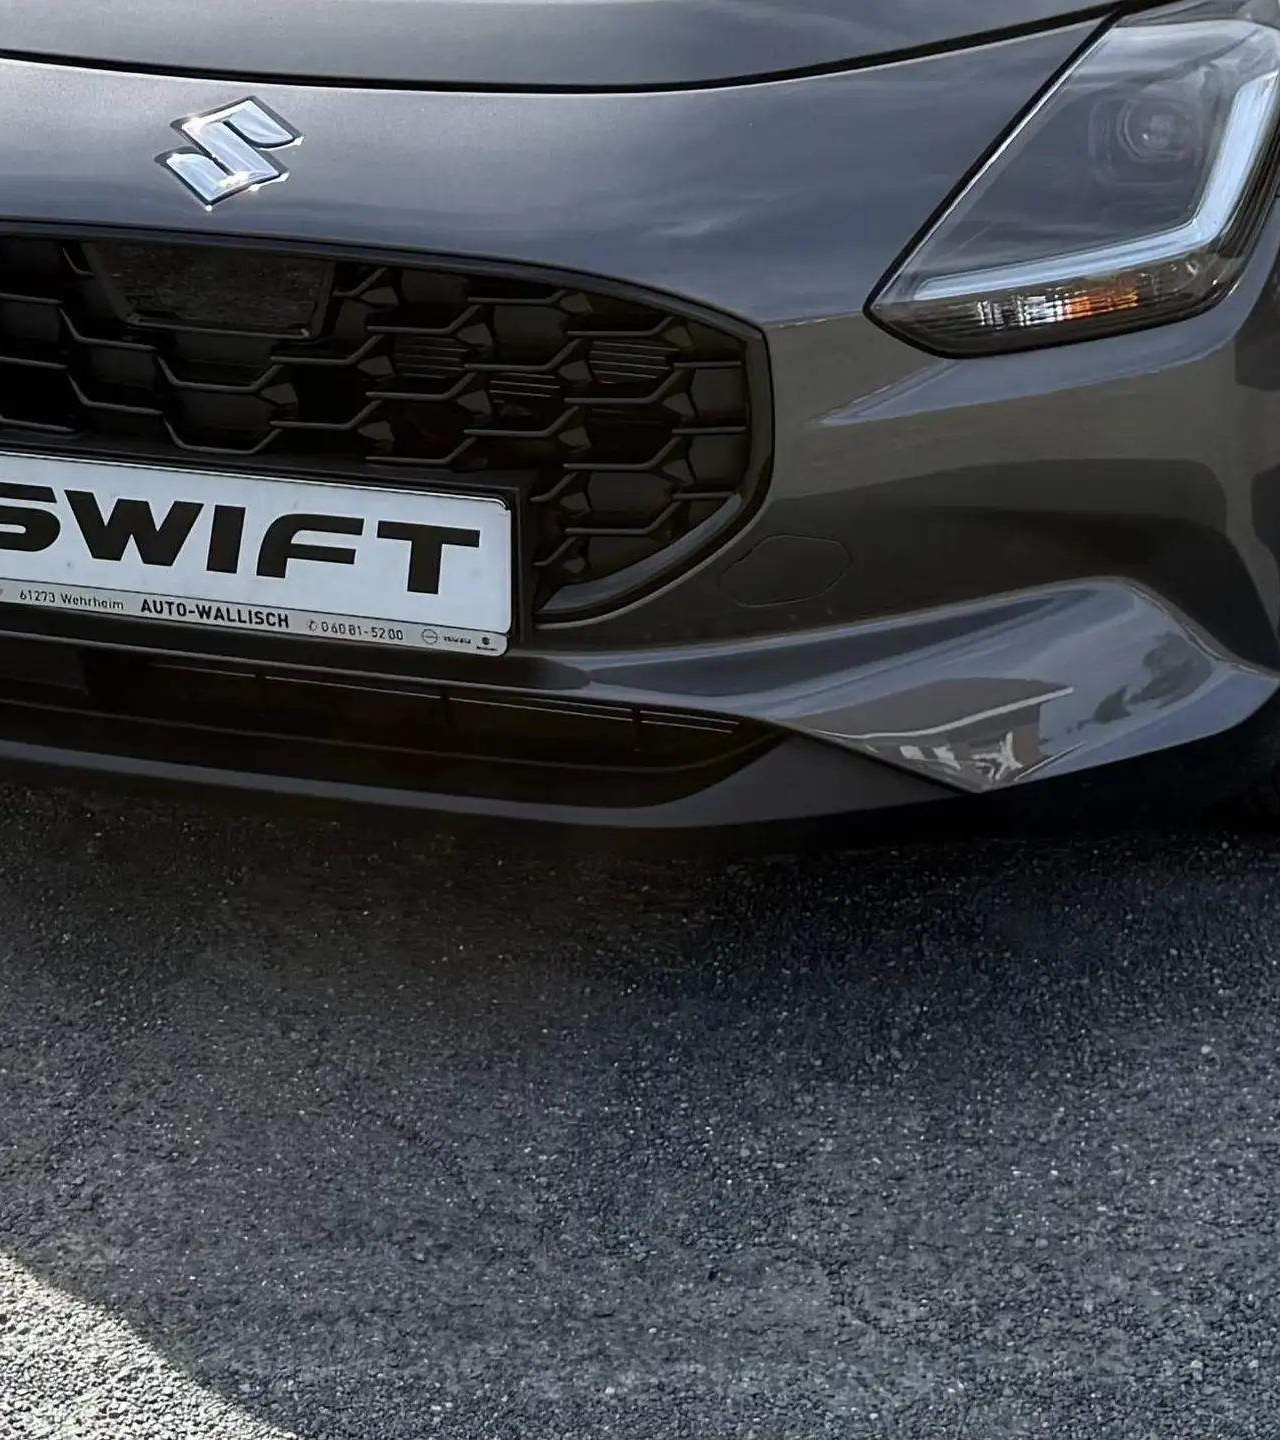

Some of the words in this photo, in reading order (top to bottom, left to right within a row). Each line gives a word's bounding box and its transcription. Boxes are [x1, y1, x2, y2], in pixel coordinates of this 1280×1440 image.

[19, 588, 56, 604] 61273
[60, 593, 125, 610] Wehrheim
[140, 598, 290, 629] AUTO-WALLISCH
[321, 620, 404, 641] 06081-5200
